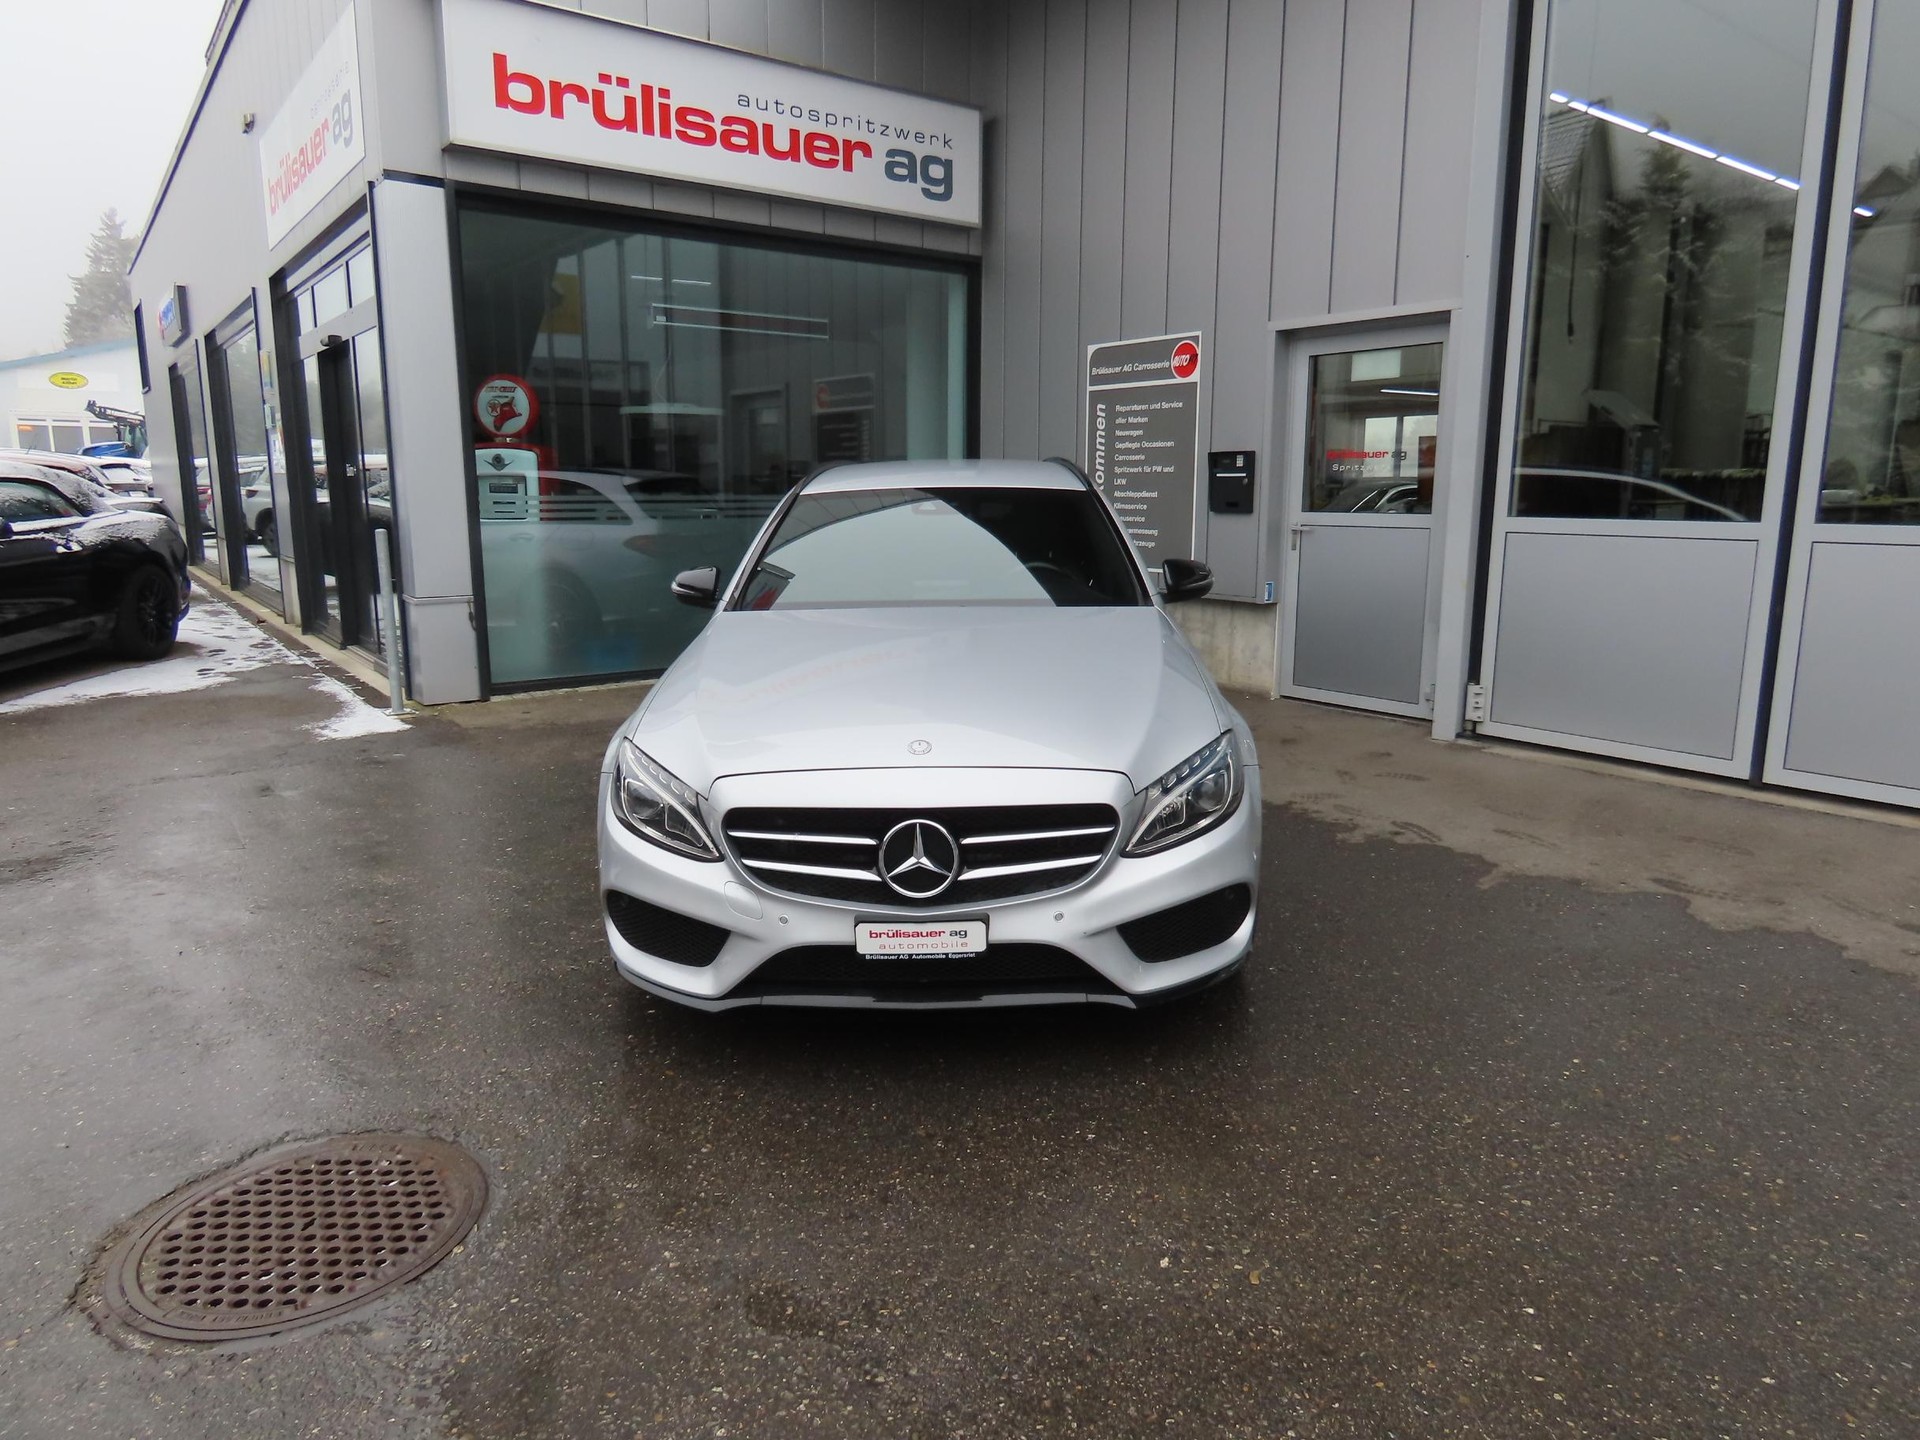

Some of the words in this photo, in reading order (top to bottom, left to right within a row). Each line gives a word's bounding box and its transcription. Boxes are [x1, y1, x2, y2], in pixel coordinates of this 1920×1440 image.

[492, 52, 873, 173] brülisauer
[885, 149, 954, 202] ag
[737, 94, 954, 150] autospritzwerk
[268, 118, 330, 216] brülisauer
[332, 89, 354, 149] ag
[1122, 363, 1132, 373] AG
[1133, 360, 1170, 372] Carrosserie
[1115, 403, 1149, 413] Reparaturen
[1149, 402, 1161, 410] und
[1161, 401, 1183, 409] Service
[1128, 416, 1149, 424] Marken
[1115, 429, 1144, 438] Neuwagen
[1115, 441, 1140, 450] Gepflegte
[1141, 440, 1175, 448] Occasionen
[1114, 453, 1146, 461] Carrosserie
[1114, 466, 1143, 475] Spritzwerk
[1143, 465, 1151, 473] für
[1152, 465, 1163, 473] PW
[1162, 465, 1175, 473] und
[1114, 478, 1127, 486] LKW
[1114, 490, 1158, 499] Abschleppdienst
[1113, 502, 1148, 510] Klimaservice
[868, 929, 946, 939] brülisauer
[949, 929, 968, 939] ag
[878, 940, 969, 950] automobile
